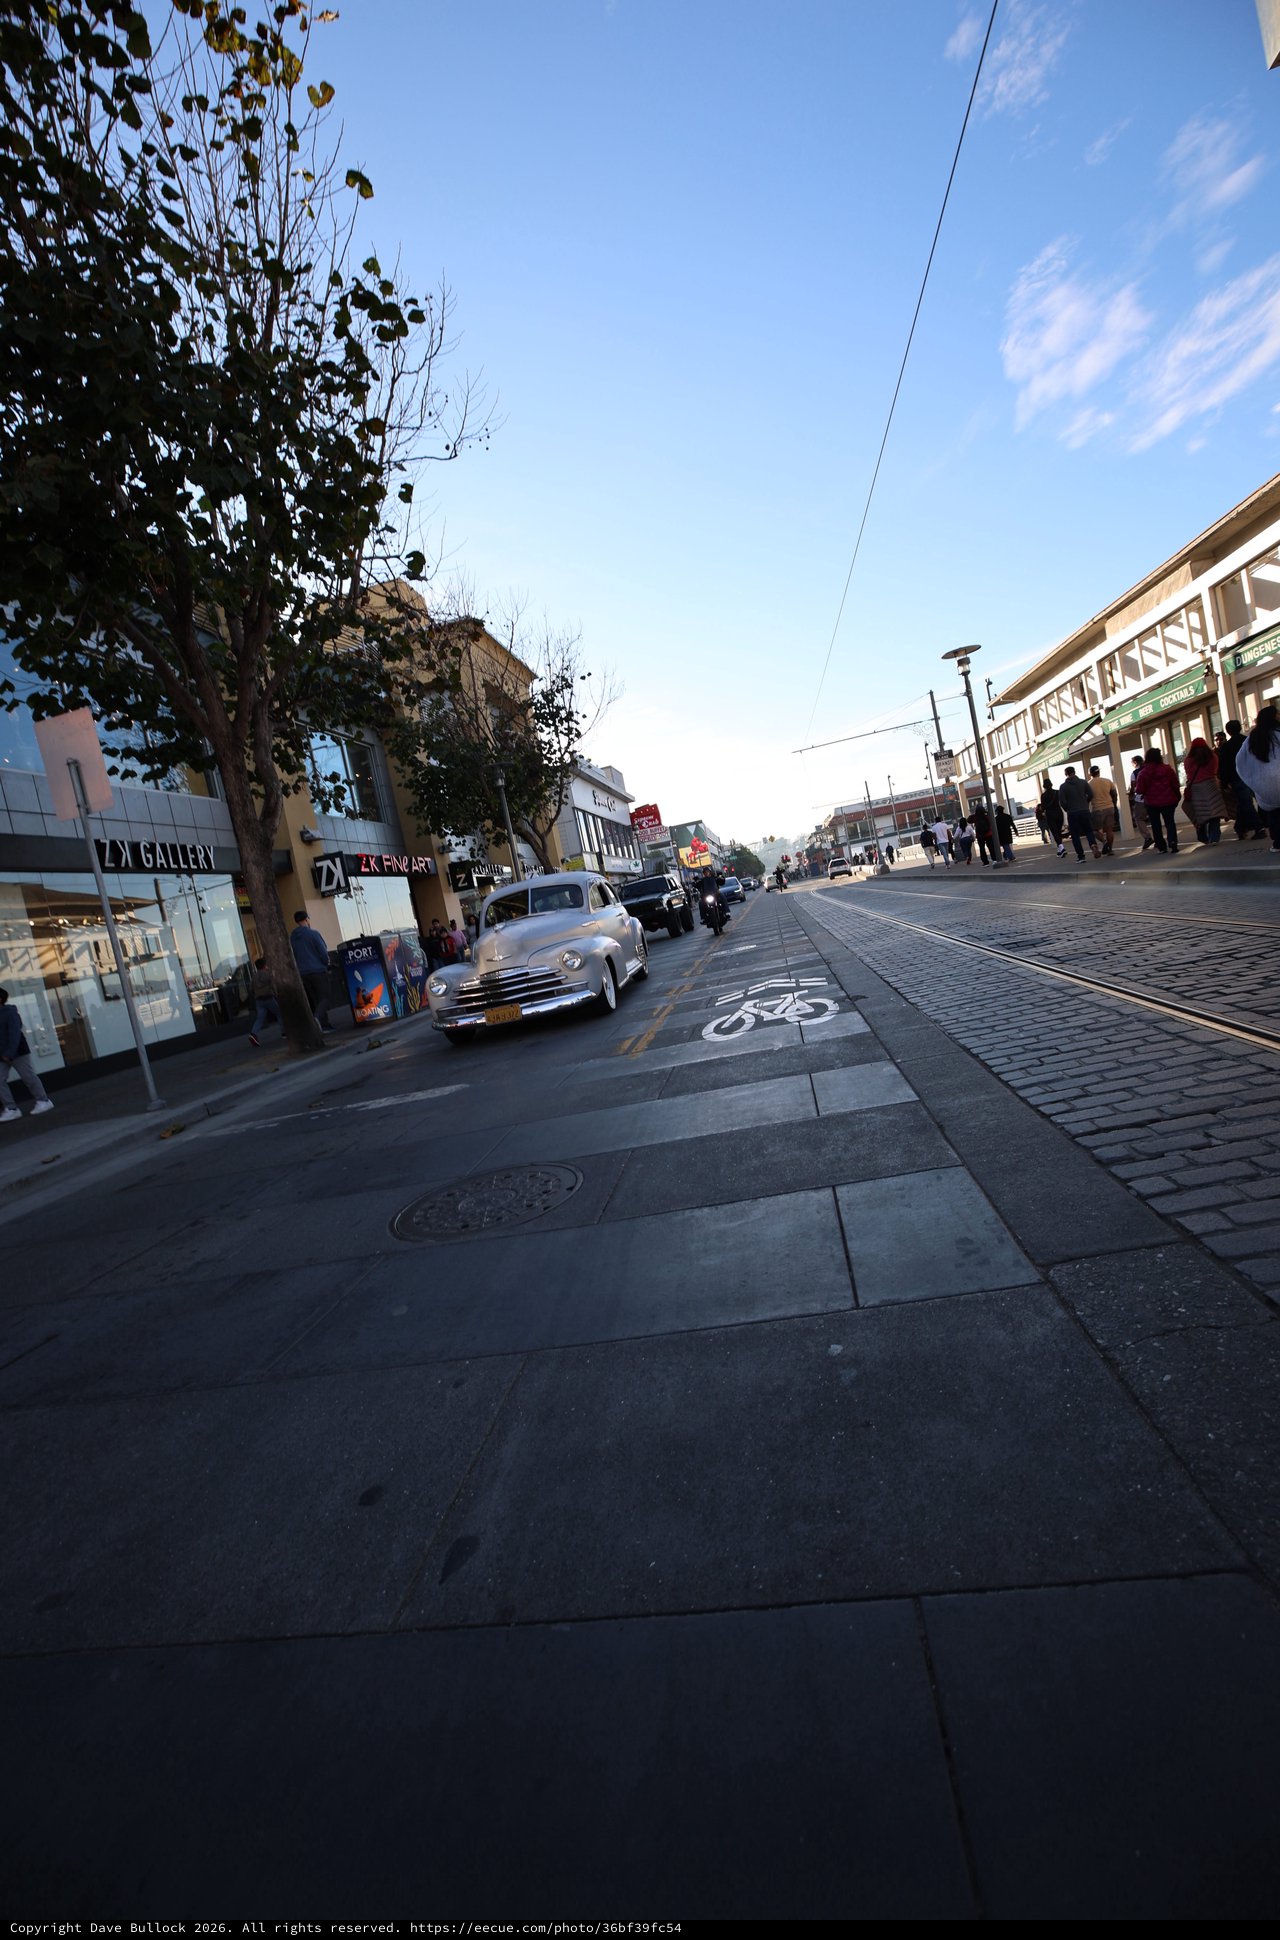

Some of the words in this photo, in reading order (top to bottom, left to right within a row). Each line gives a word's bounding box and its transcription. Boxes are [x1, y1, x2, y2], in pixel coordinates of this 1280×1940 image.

[1138, 704, 1154, 718] BEER
[1159, 685, 1195, 708] COCKTAILS
[139, 841, 216, 870] GALLERY
[357, 853, 380, 873] ZK
[382, 854, 410, 873] FINE
[411, 857, 432, 873] ART
[348, 947, 373, 960] PORT
